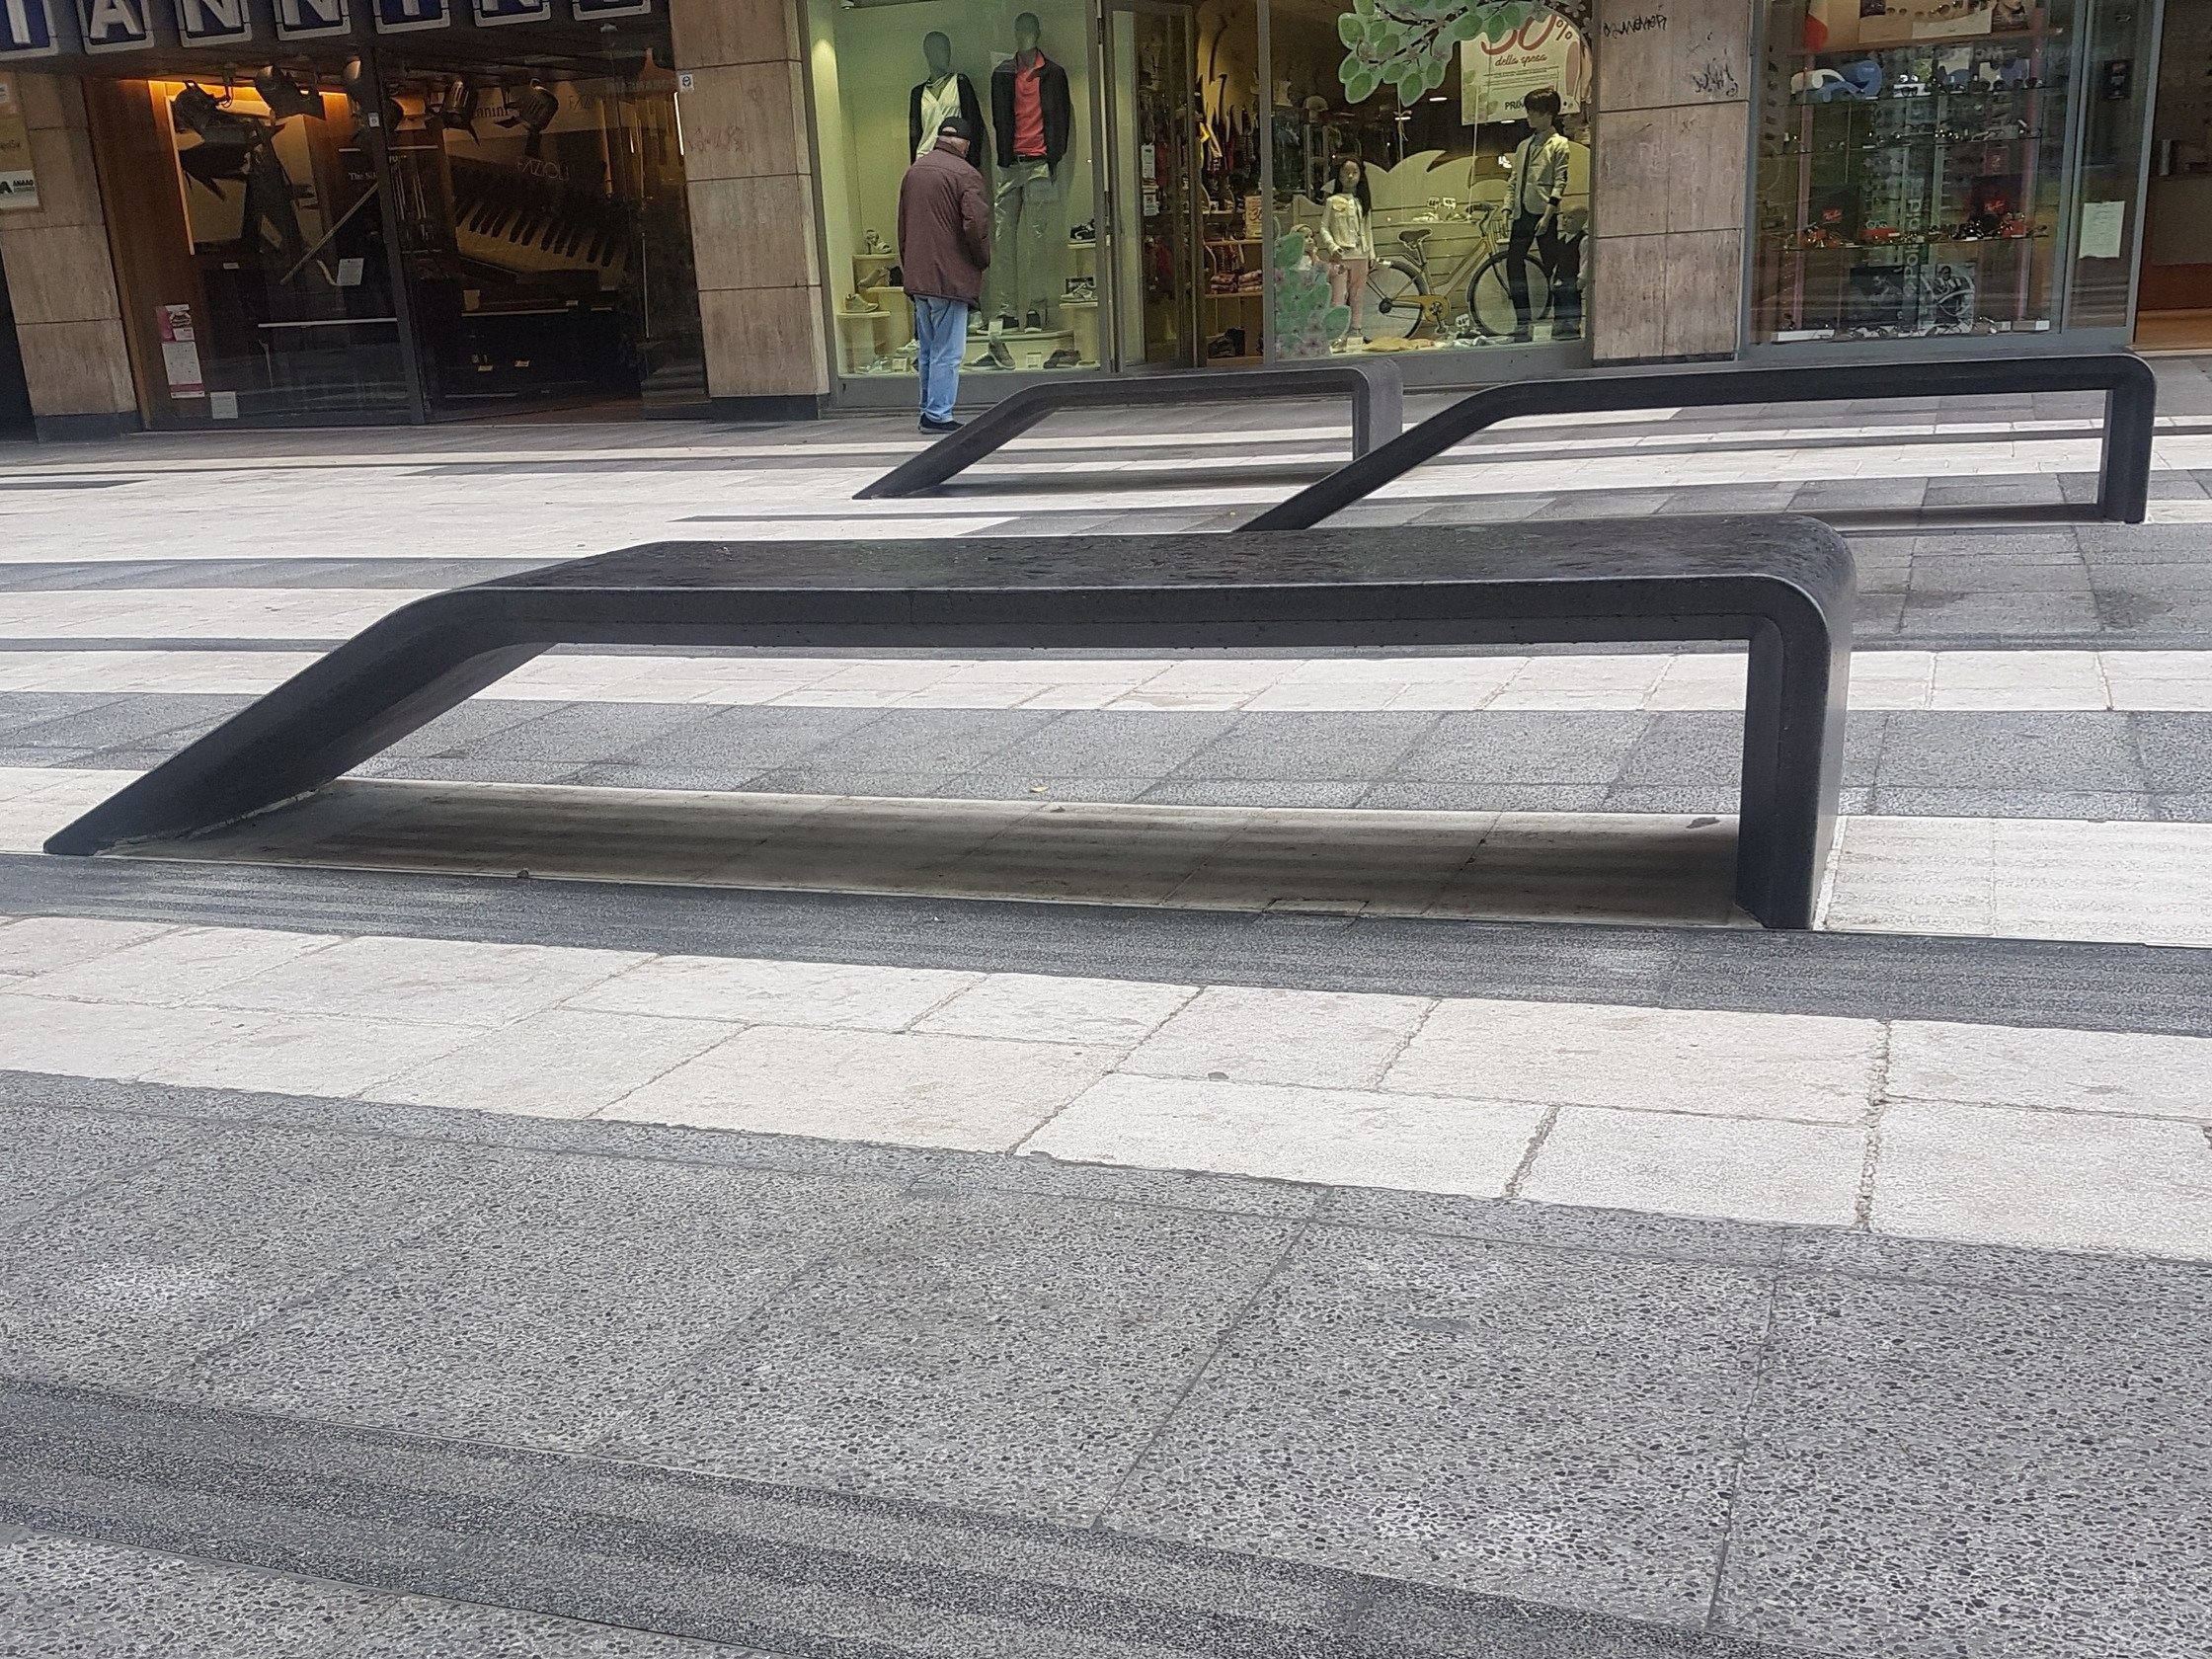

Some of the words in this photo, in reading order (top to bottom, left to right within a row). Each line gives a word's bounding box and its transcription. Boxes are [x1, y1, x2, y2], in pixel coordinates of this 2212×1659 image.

[1494, 54, 1519, 67] della
[1521, 53, 1548, 67] spesa
[1905, 198, 1922, 277] Poloid
